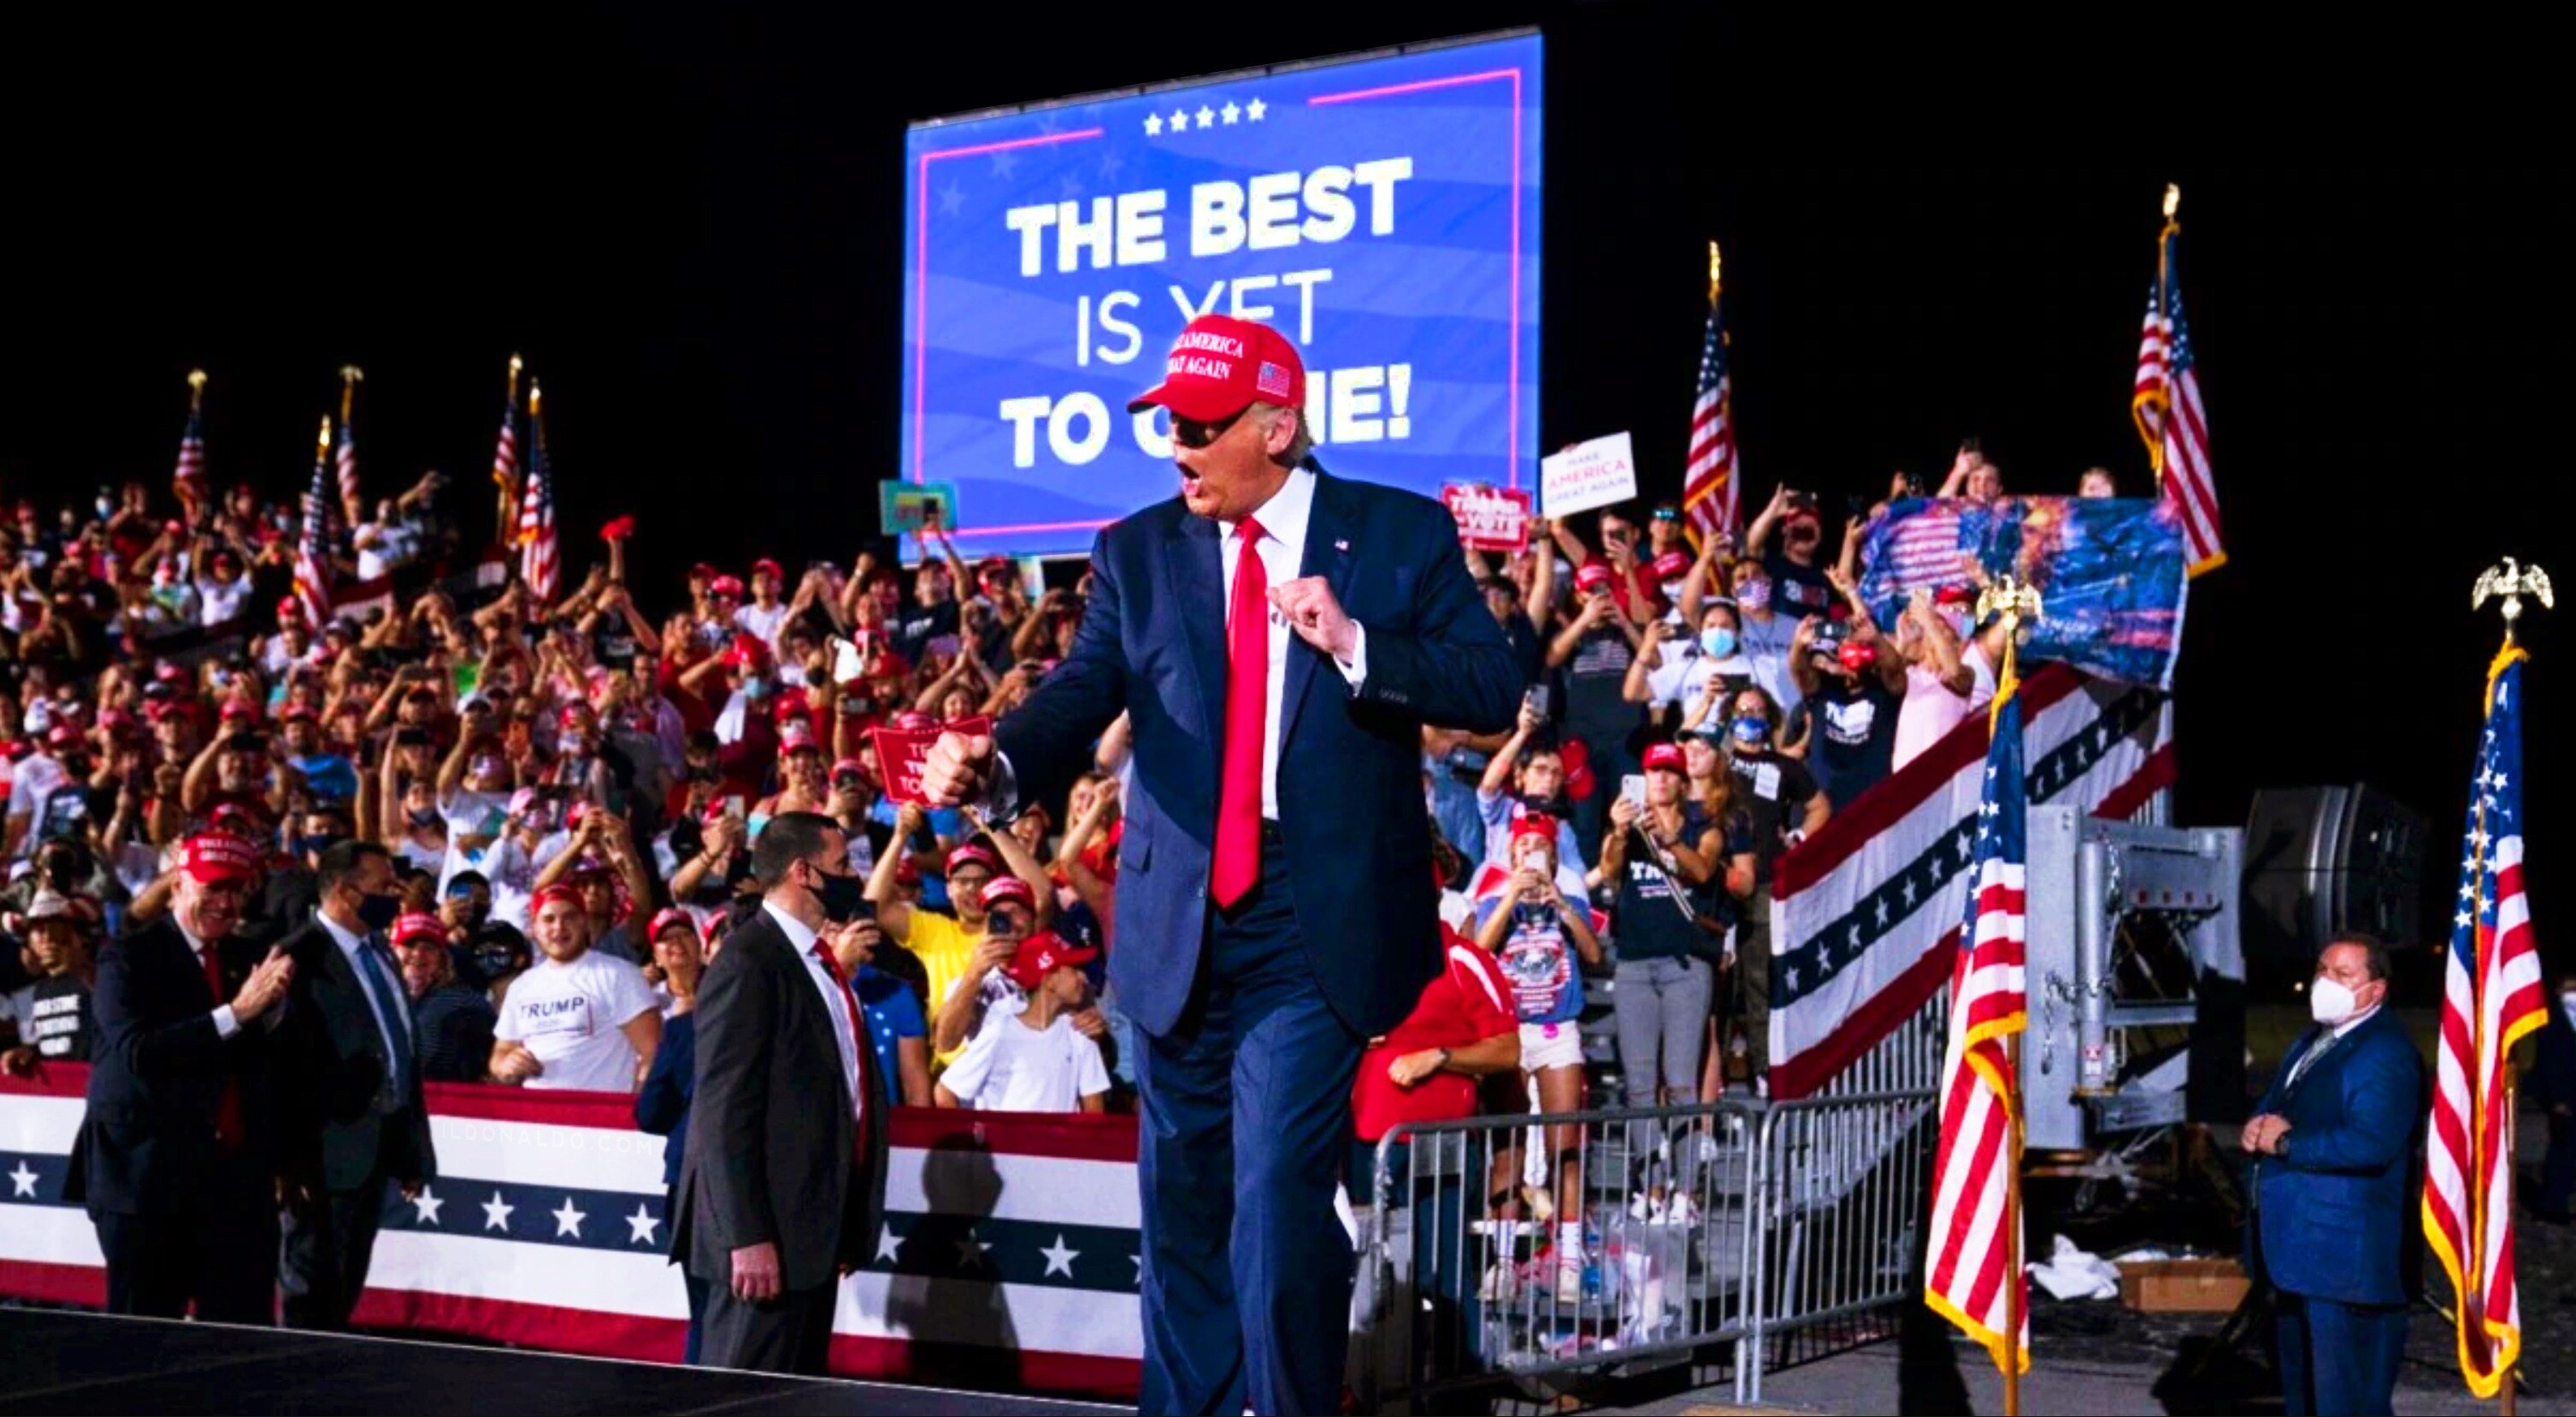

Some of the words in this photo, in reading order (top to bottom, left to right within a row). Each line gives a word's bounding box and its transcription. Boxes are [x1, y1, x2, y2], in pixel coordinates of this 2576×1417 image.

[1006, 189, 1167, 277] THE
[1190, 156, 1413, 258] BEST
[1077, 290, 1143, 367] IS
[1184, 356, 1232, 380] AGAIN
[1000, 392, 1111, 469] TO
[1132, 363, 1412, 460] CE!
[1567, 452, 1600, 466] MAKE
[1548, 460, 1627, 490] AMERICA
[1547, 483, 1586, 504] GREAT
[1590, 476, 1630, 492] AGAIN
[521, 996, 585, 1018] TRUMP
